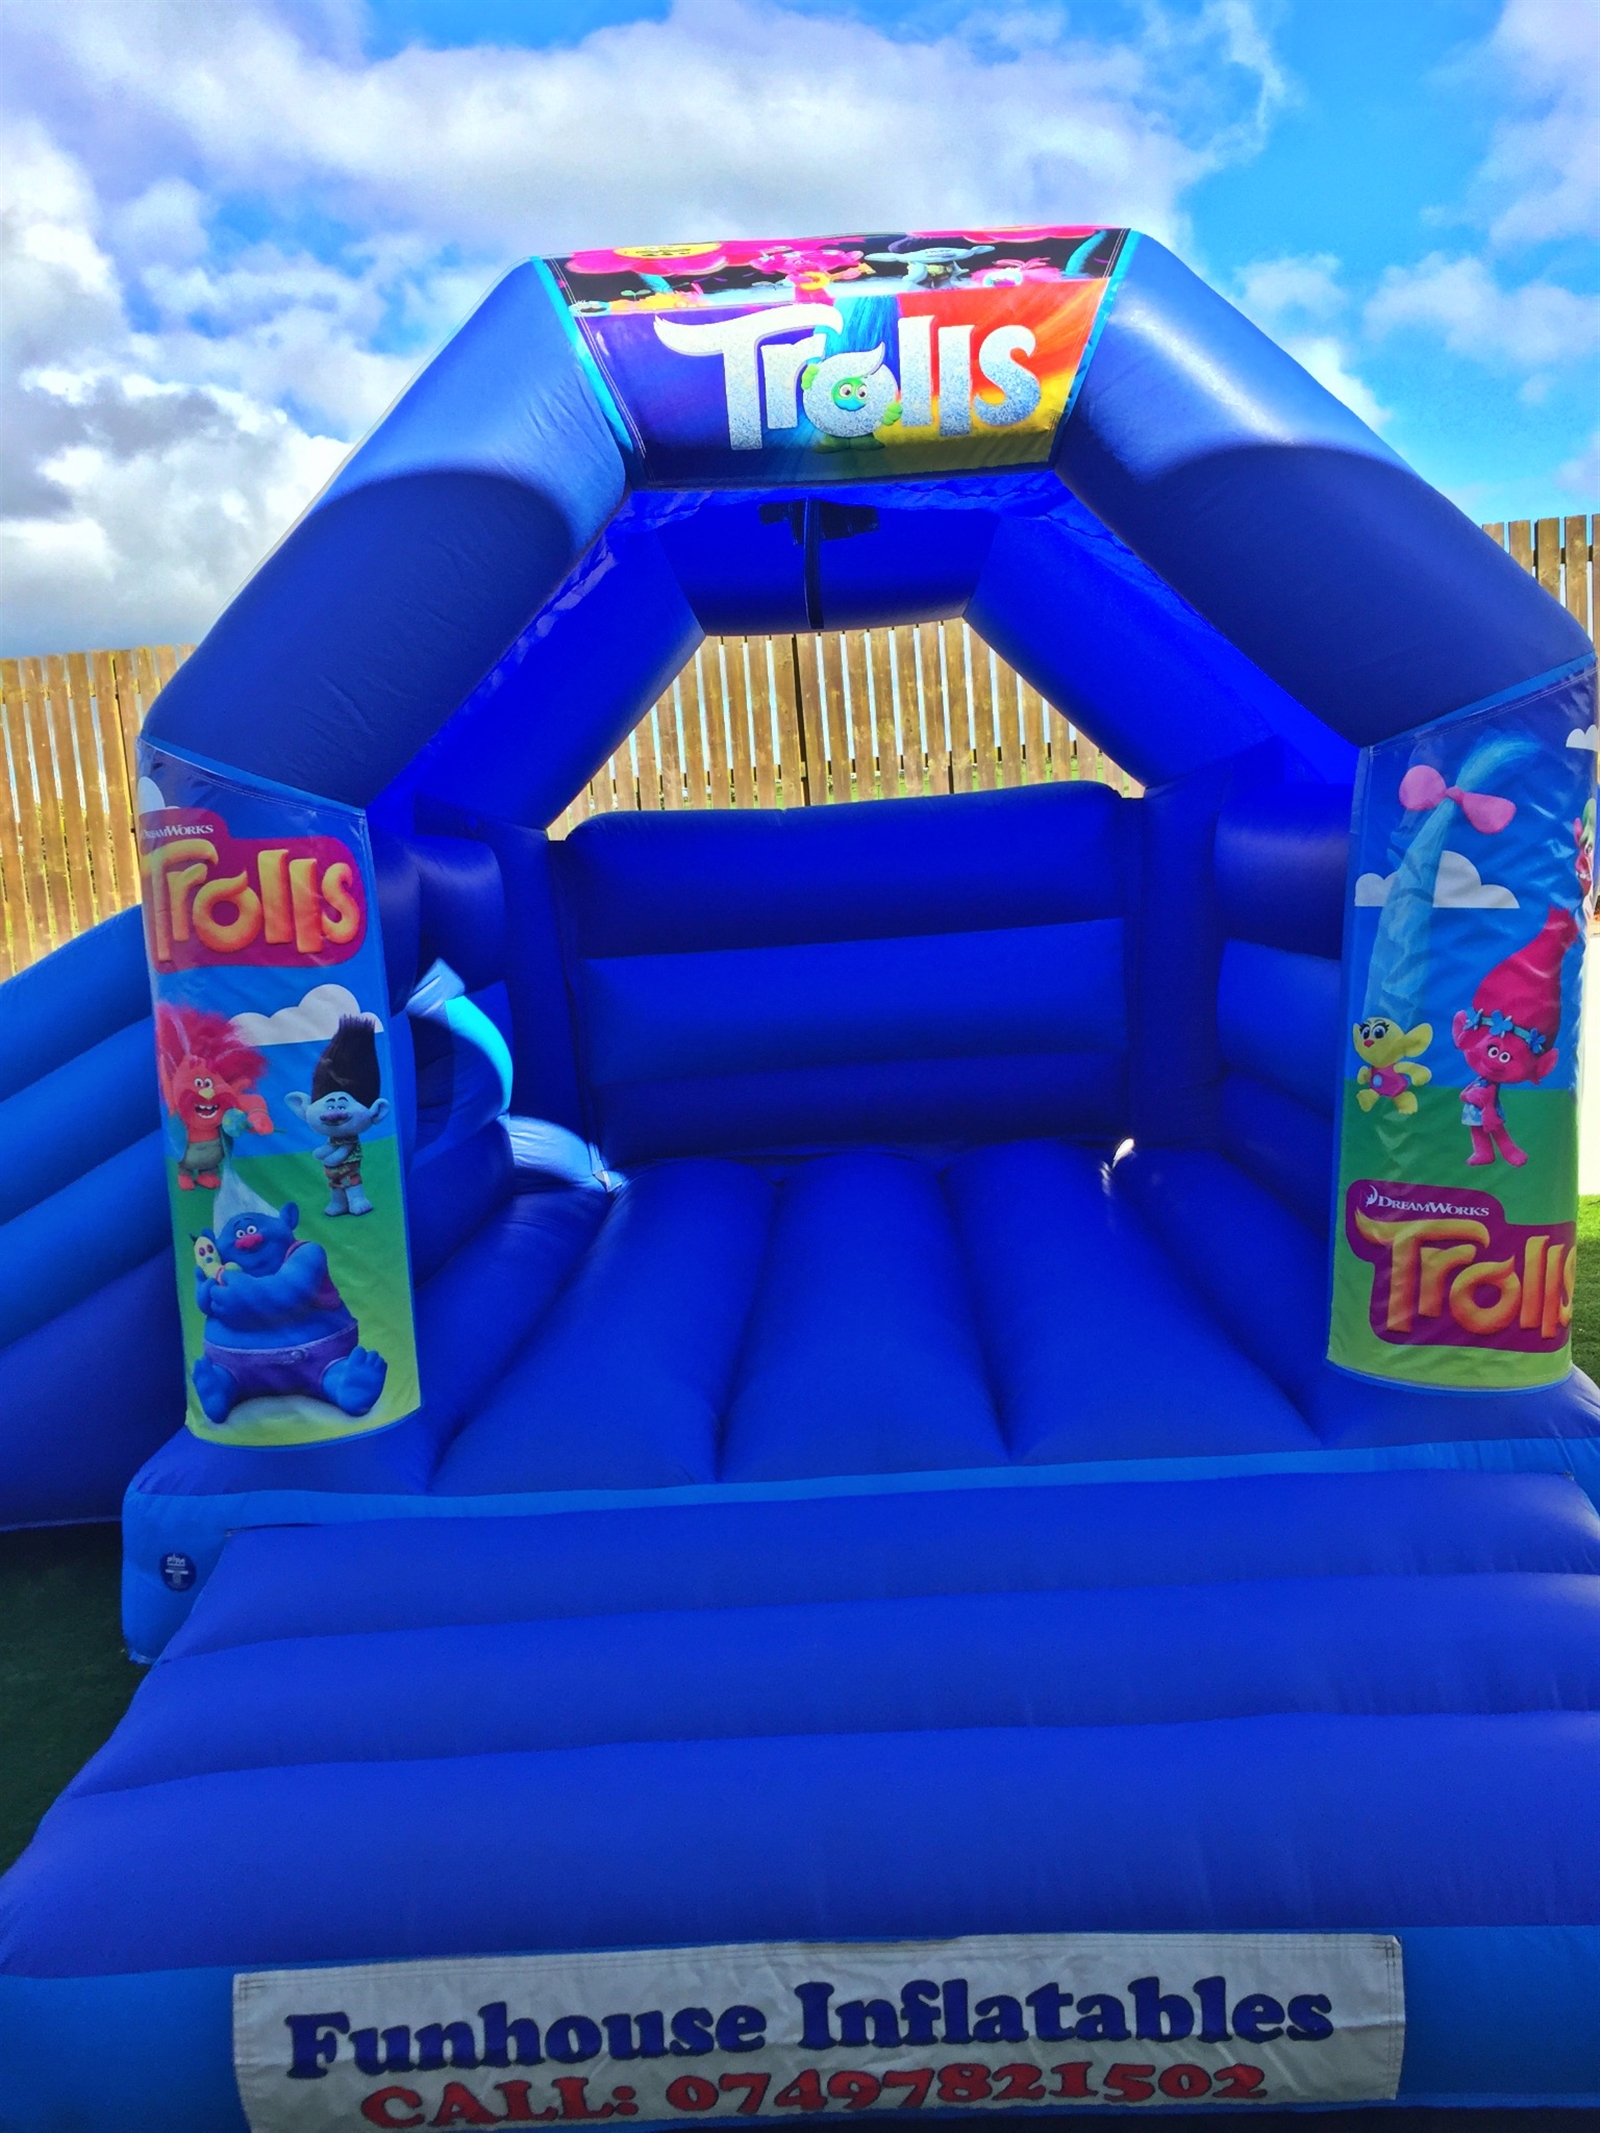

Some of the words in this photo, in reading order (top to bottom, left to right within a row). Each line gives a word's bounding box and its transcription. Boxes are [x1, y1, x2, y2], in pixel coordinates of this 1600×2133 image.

[653, 303, 1041, 451] Trolls
[139, 839, 360, 962] Trolls
[286, 2001, 767, 2080] Funhouse
[794, 1977, 1334, 2051] Inflatables
[360, 2076, 640, 2129] CALL:
[665, 2066, 1268, 2115] 07497821502
